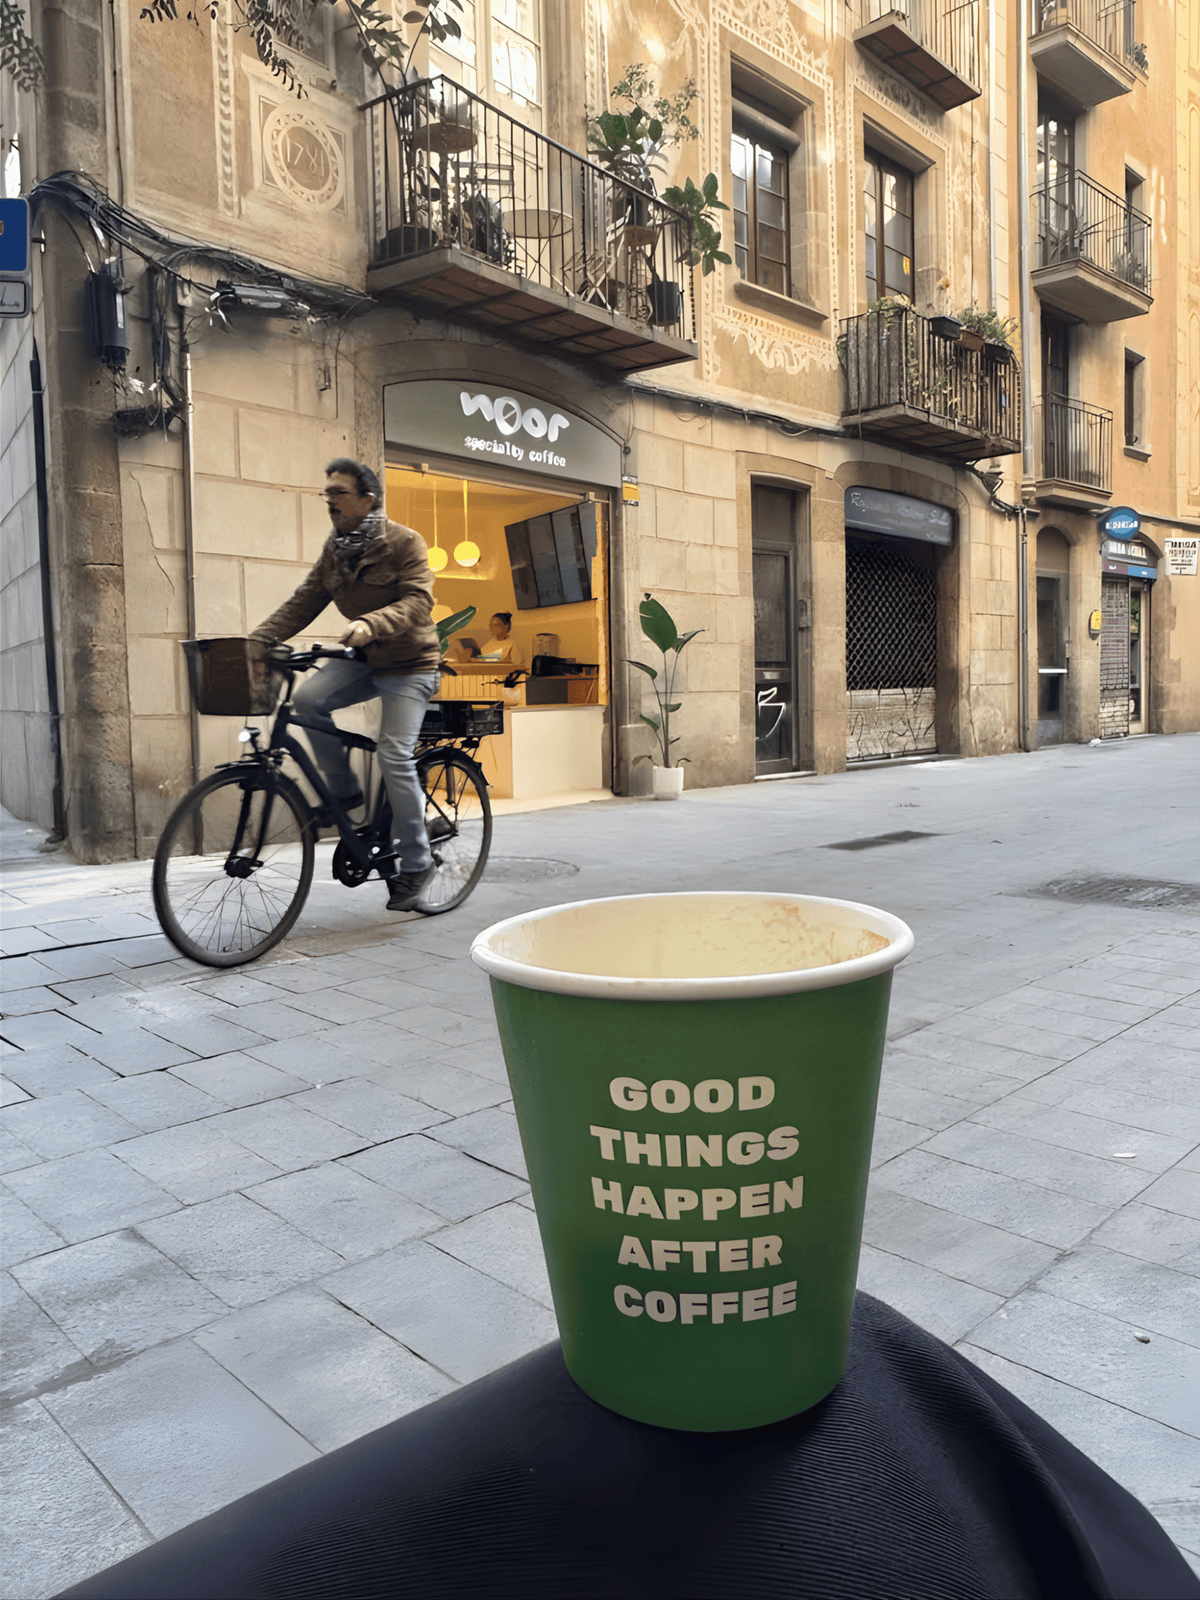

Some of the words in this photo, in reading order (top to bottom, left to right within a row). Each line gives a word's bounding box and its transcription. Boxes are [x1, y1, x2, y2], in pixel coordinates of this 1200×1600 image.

[464, 436, 524, 461] specialty
[528, 449, 567, 467] coffee
[609, 1075, 775, 1114] GOOD
[589, 1124, 800, 1168] THINGS
[591, 1175, 804, 1221] HAPPEN
[617, 1234, 783, 1273] AFTER
[613, 1280, 798, 1325] COFFEE
